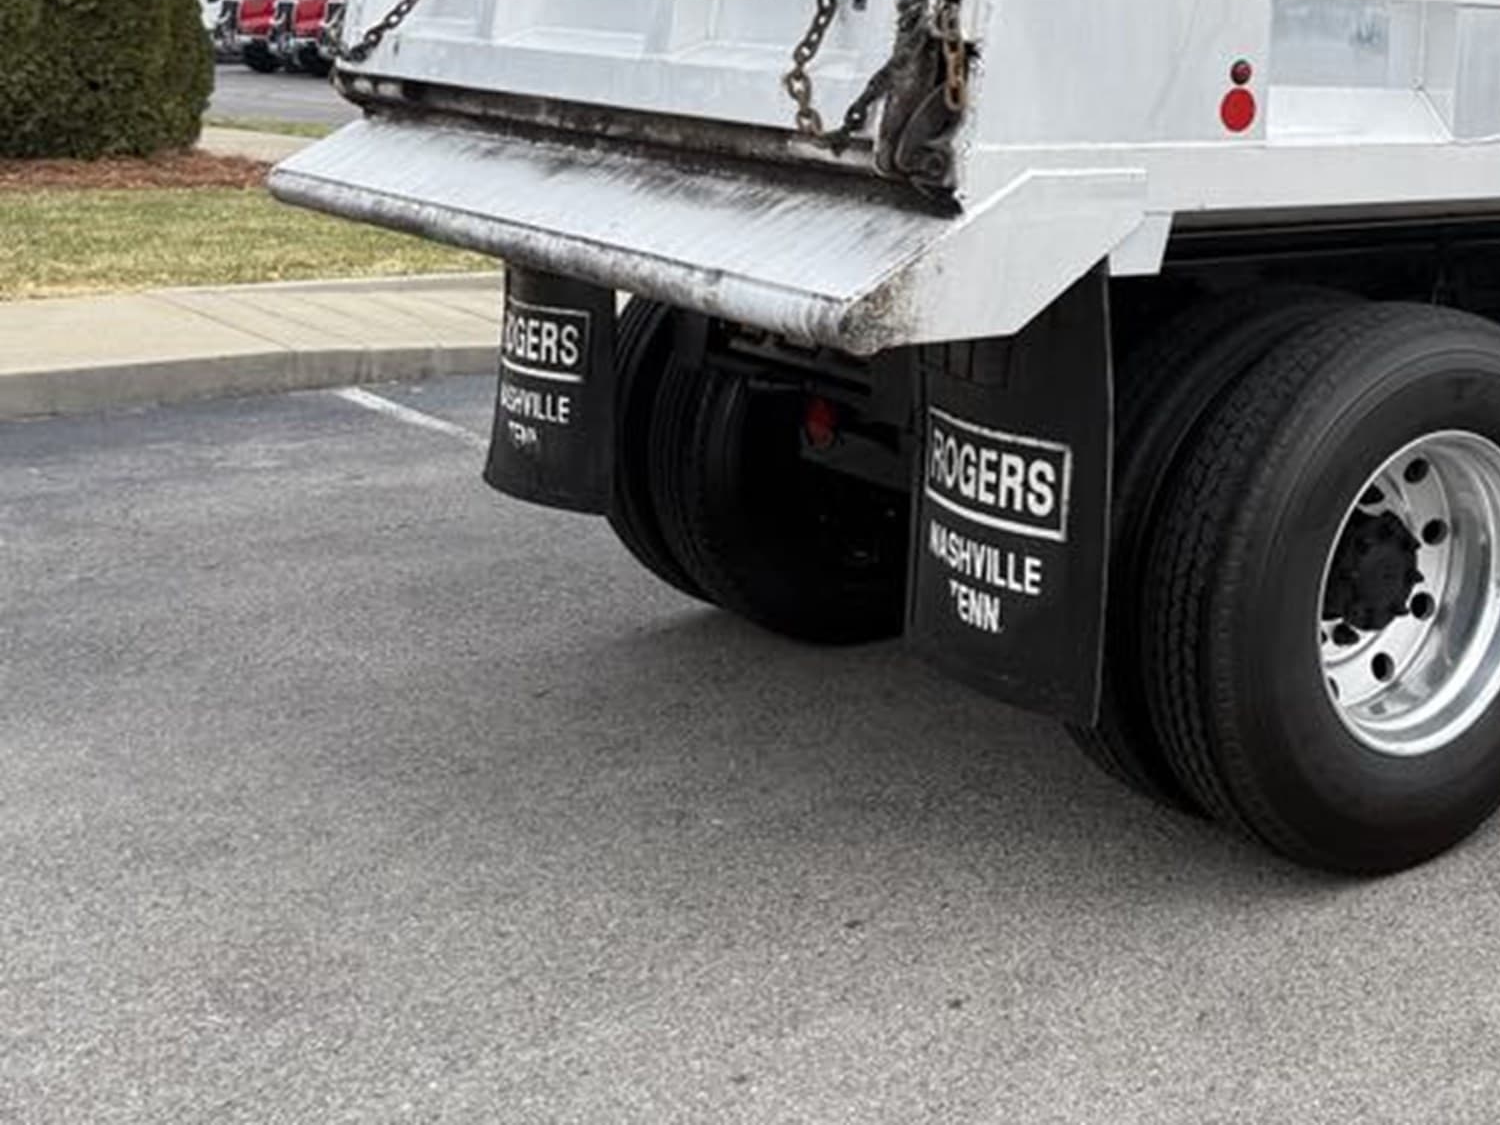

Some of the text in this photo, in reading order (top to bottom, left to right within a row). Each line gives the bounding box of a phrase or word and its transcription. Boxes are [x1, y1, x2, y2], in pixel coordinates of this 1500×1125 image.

[506, 311, 578, 366] OGERS
[931, 429, 1056, 517] ROGERS
[930, 519, 1042, 595] NASHVILLE
